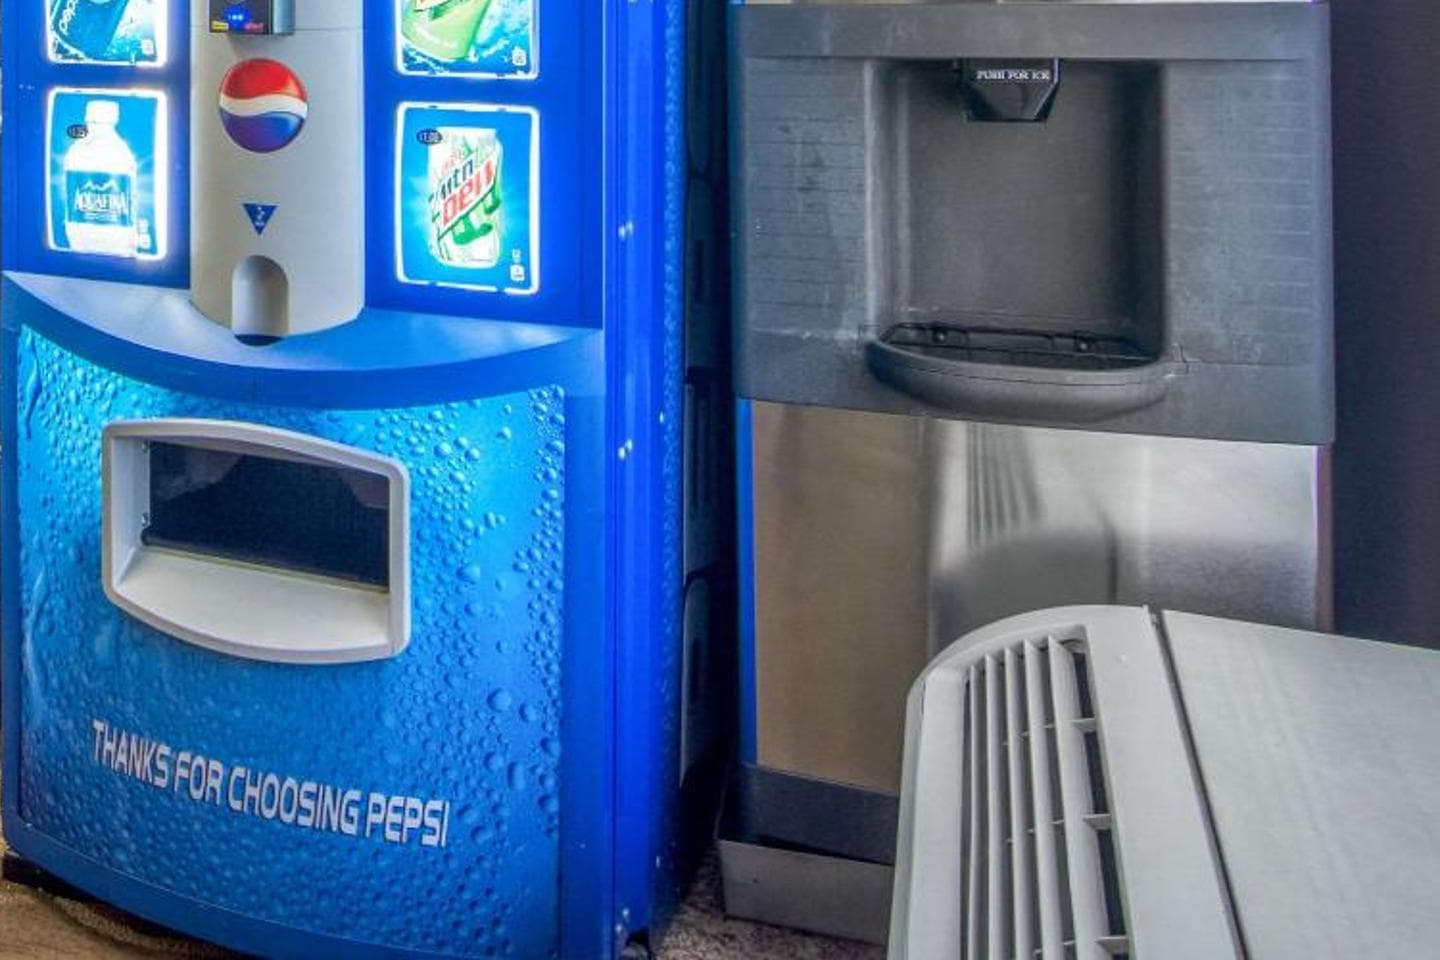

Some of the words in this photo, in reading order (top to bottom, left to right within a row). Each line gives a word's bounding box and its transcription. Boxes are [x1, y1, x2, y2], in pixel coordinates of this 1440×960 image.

[92, 719, 171, 790] THANKS
[173, 750, 224, 806] FOR
[227, 766, 361, 836] CHOOSING
[365, 792, 450, 849] PEPSI
